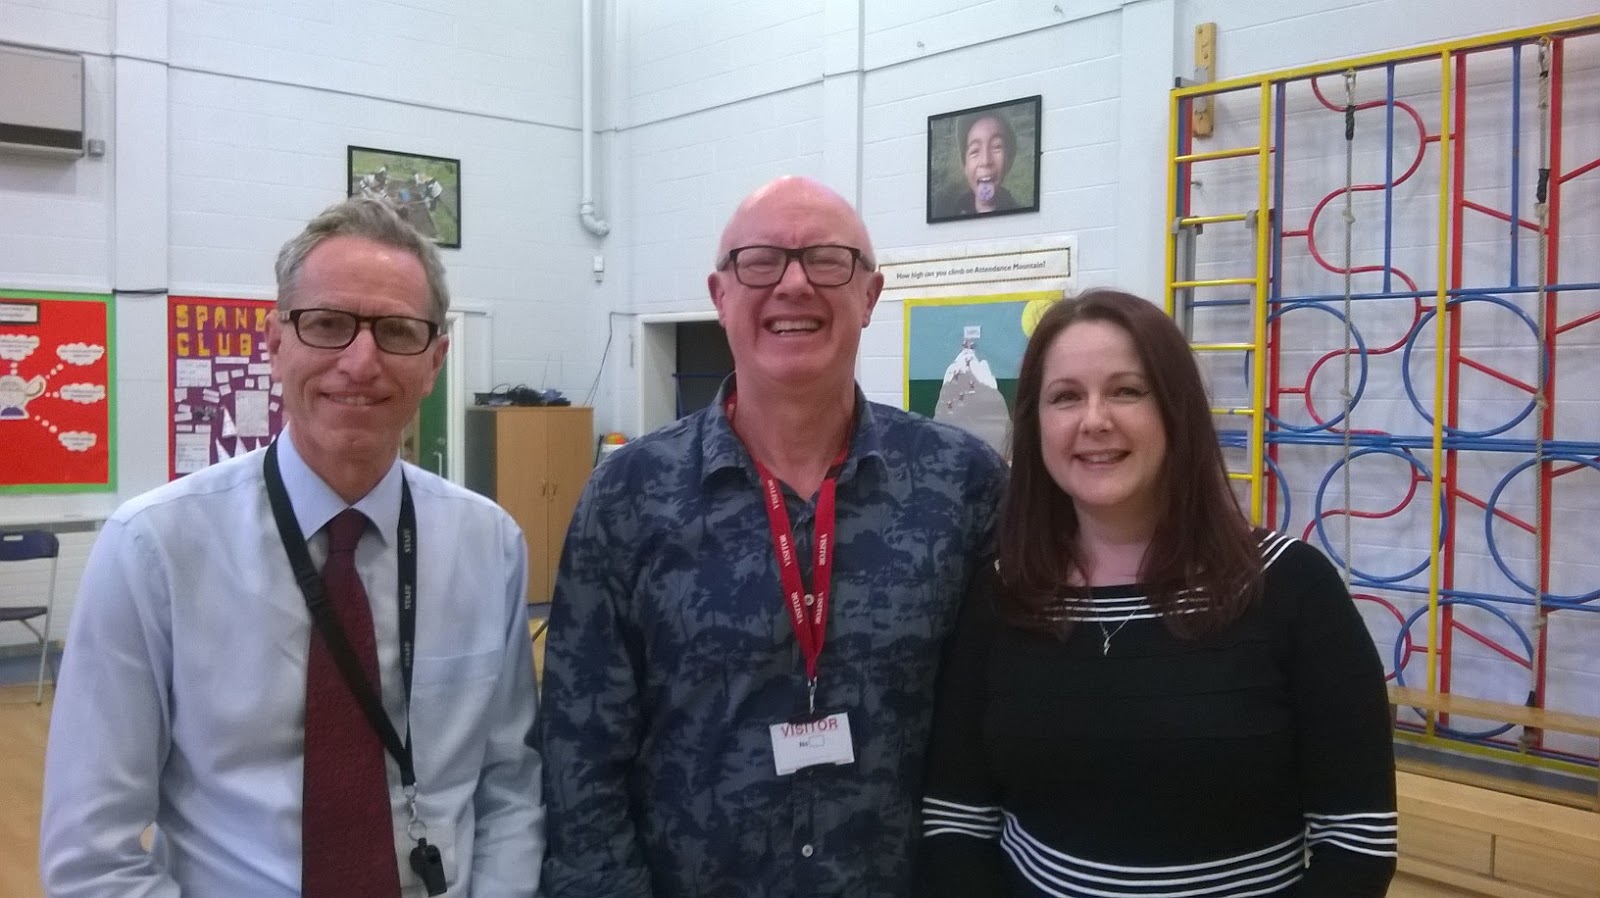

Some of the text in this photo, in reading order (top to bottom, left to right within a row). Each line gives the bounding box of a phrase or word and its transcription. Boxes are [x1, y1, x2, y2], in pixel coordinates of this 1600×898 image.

[911, 271, 923, 279] high
[936, 270, 947, 278] you
[975, 265, 1011, 273] Attendance
[1013, 260, 1046, 270] Mountain?
[176, 333, 252, 356] CLUB
[767, 479, 780, 510] VISITOR
[779, 533, 792, 567] VISITOR
[818, 533, 828, 567] VISITOR
[791, 591, 804, 625] VISITOR
[814, 591, 824, 625] VISITOR
[781, 717, 838, 737] VISITOR
